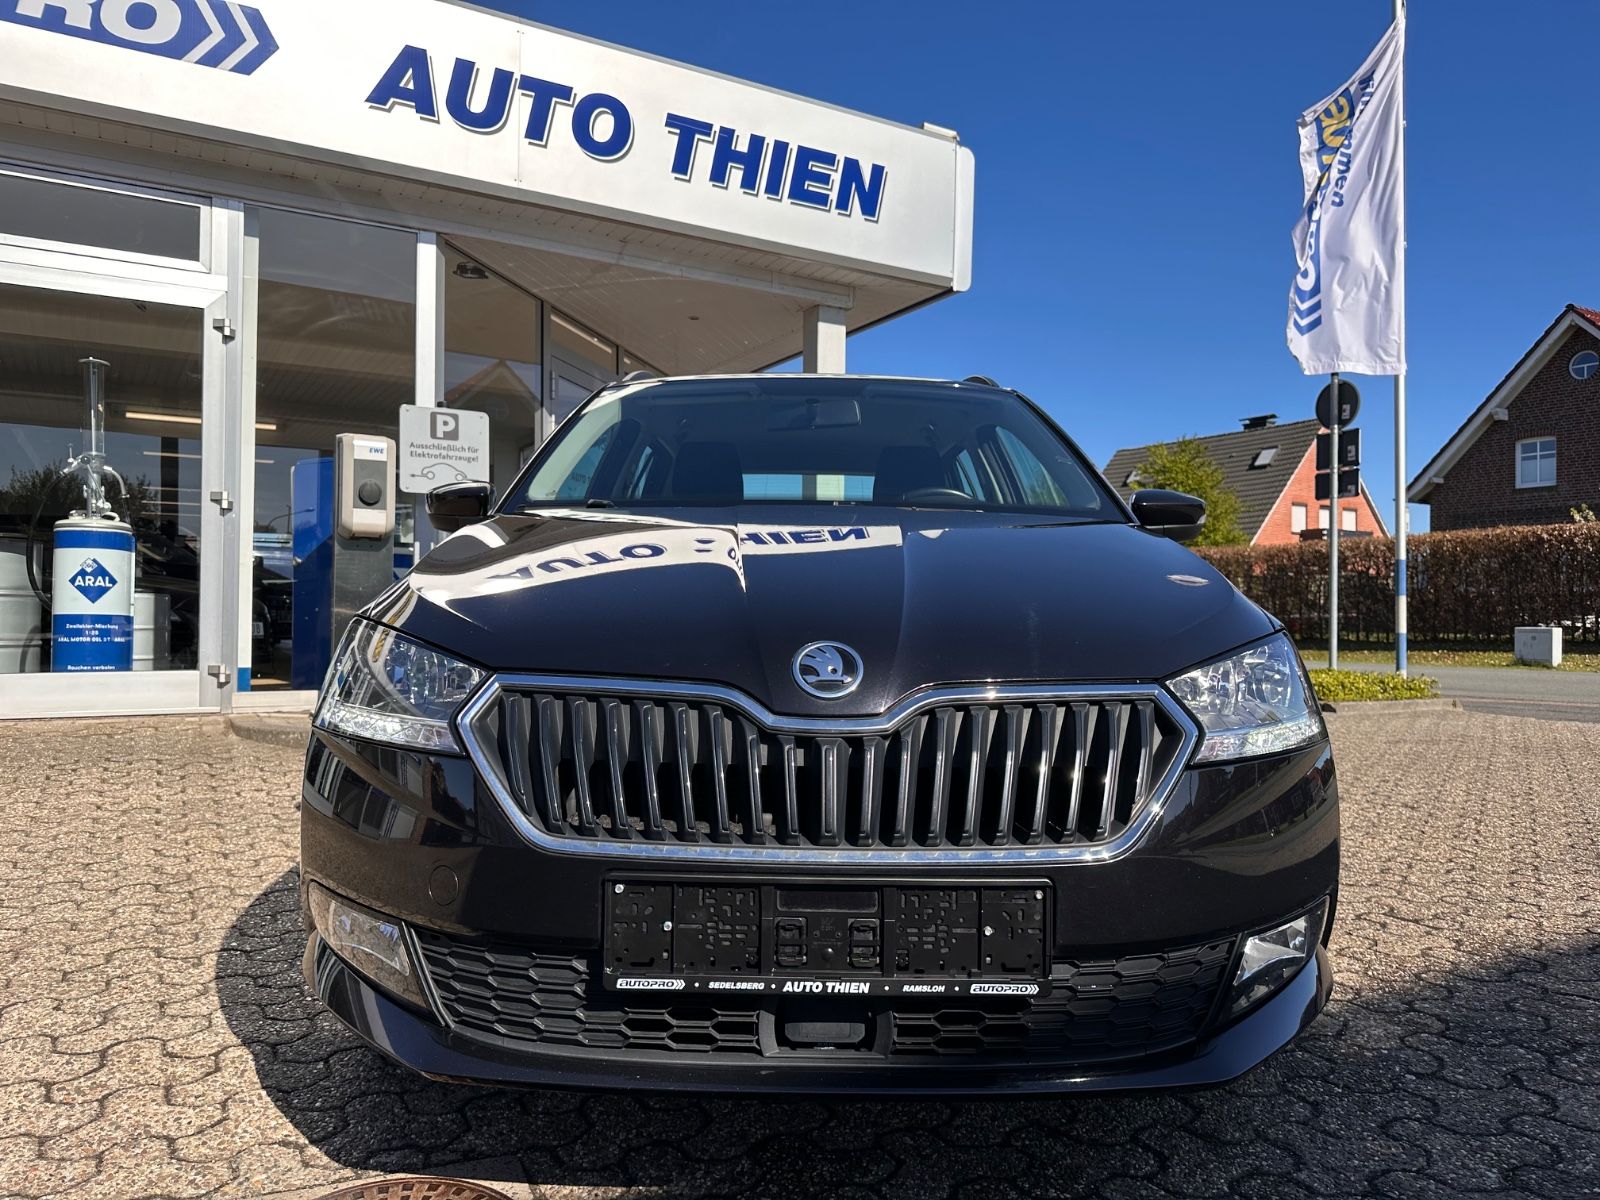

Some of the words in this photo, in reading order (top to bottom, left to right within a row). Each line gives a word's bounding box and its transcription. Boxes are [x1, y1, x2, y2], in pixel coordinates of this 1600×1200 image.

[365, 45, 633, 160] AUTO
[665, 112, 886, 220] THIEN
[436, 414, 456, 438] P
[409, 441, 466, 453] Ausschließlich
[467, 446, 479, 454] für
[74, 575, 113, 587] ARAL
[708, 981, 765, 990] SEDELSBERG
[783, 981, 824, 993] AUTO
[825, 982, 870, 994] THIEN
[902, 984, 945, 993] RAMSLOH
